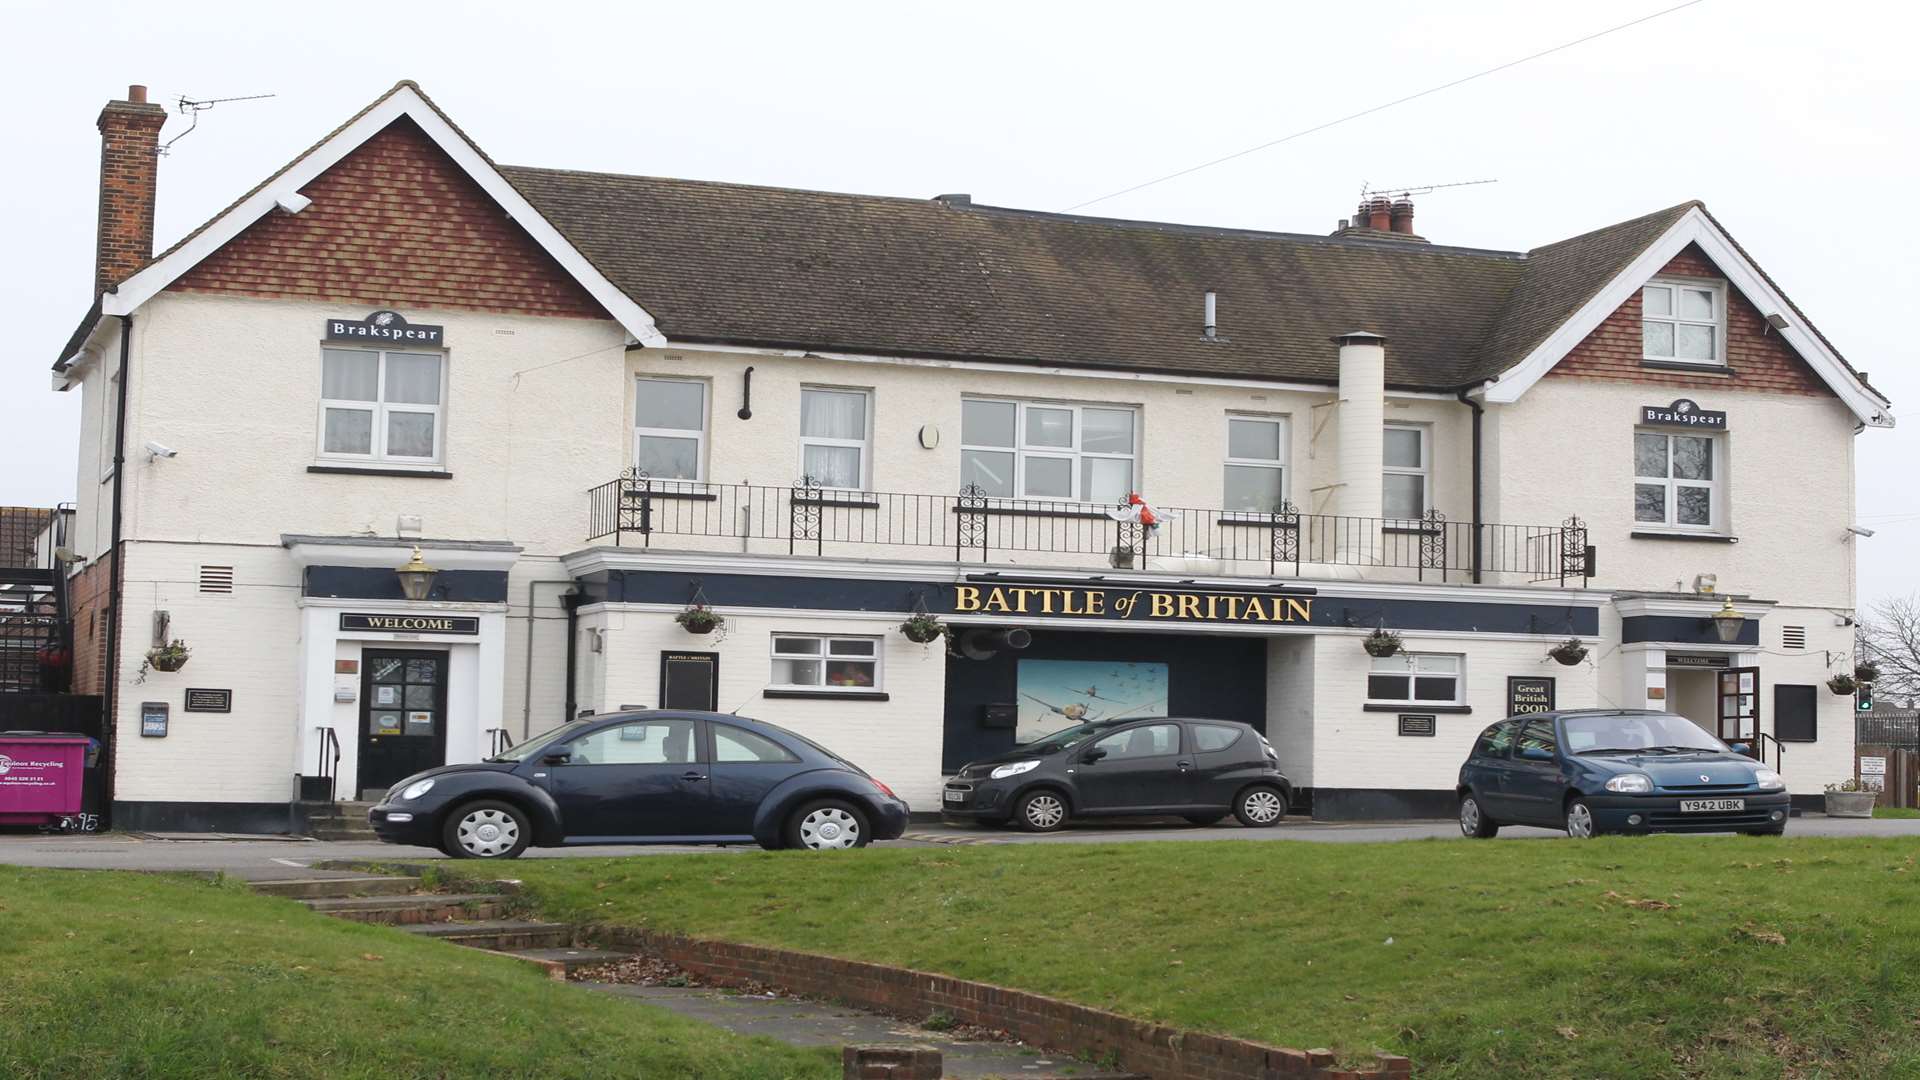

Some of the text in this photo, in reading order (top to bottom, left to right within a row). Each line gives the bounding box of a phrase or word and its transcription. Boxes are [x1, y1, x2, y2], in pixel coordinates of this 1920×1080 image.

[333, 322, 438, 340] Brakspear
[1647, 410, 1723, 425] Brakspear
[955, 586, 1313, 622] BATTLE of BRITAIN
[367, 617, 454, 630] WELCOME
[1517, 684, 1545, 693] Great
[1514, 694, 1548, 703] British
[1514, 704, 1549, 713] FOOD
[1684, 800, 1740, 811] Y942 UBK
